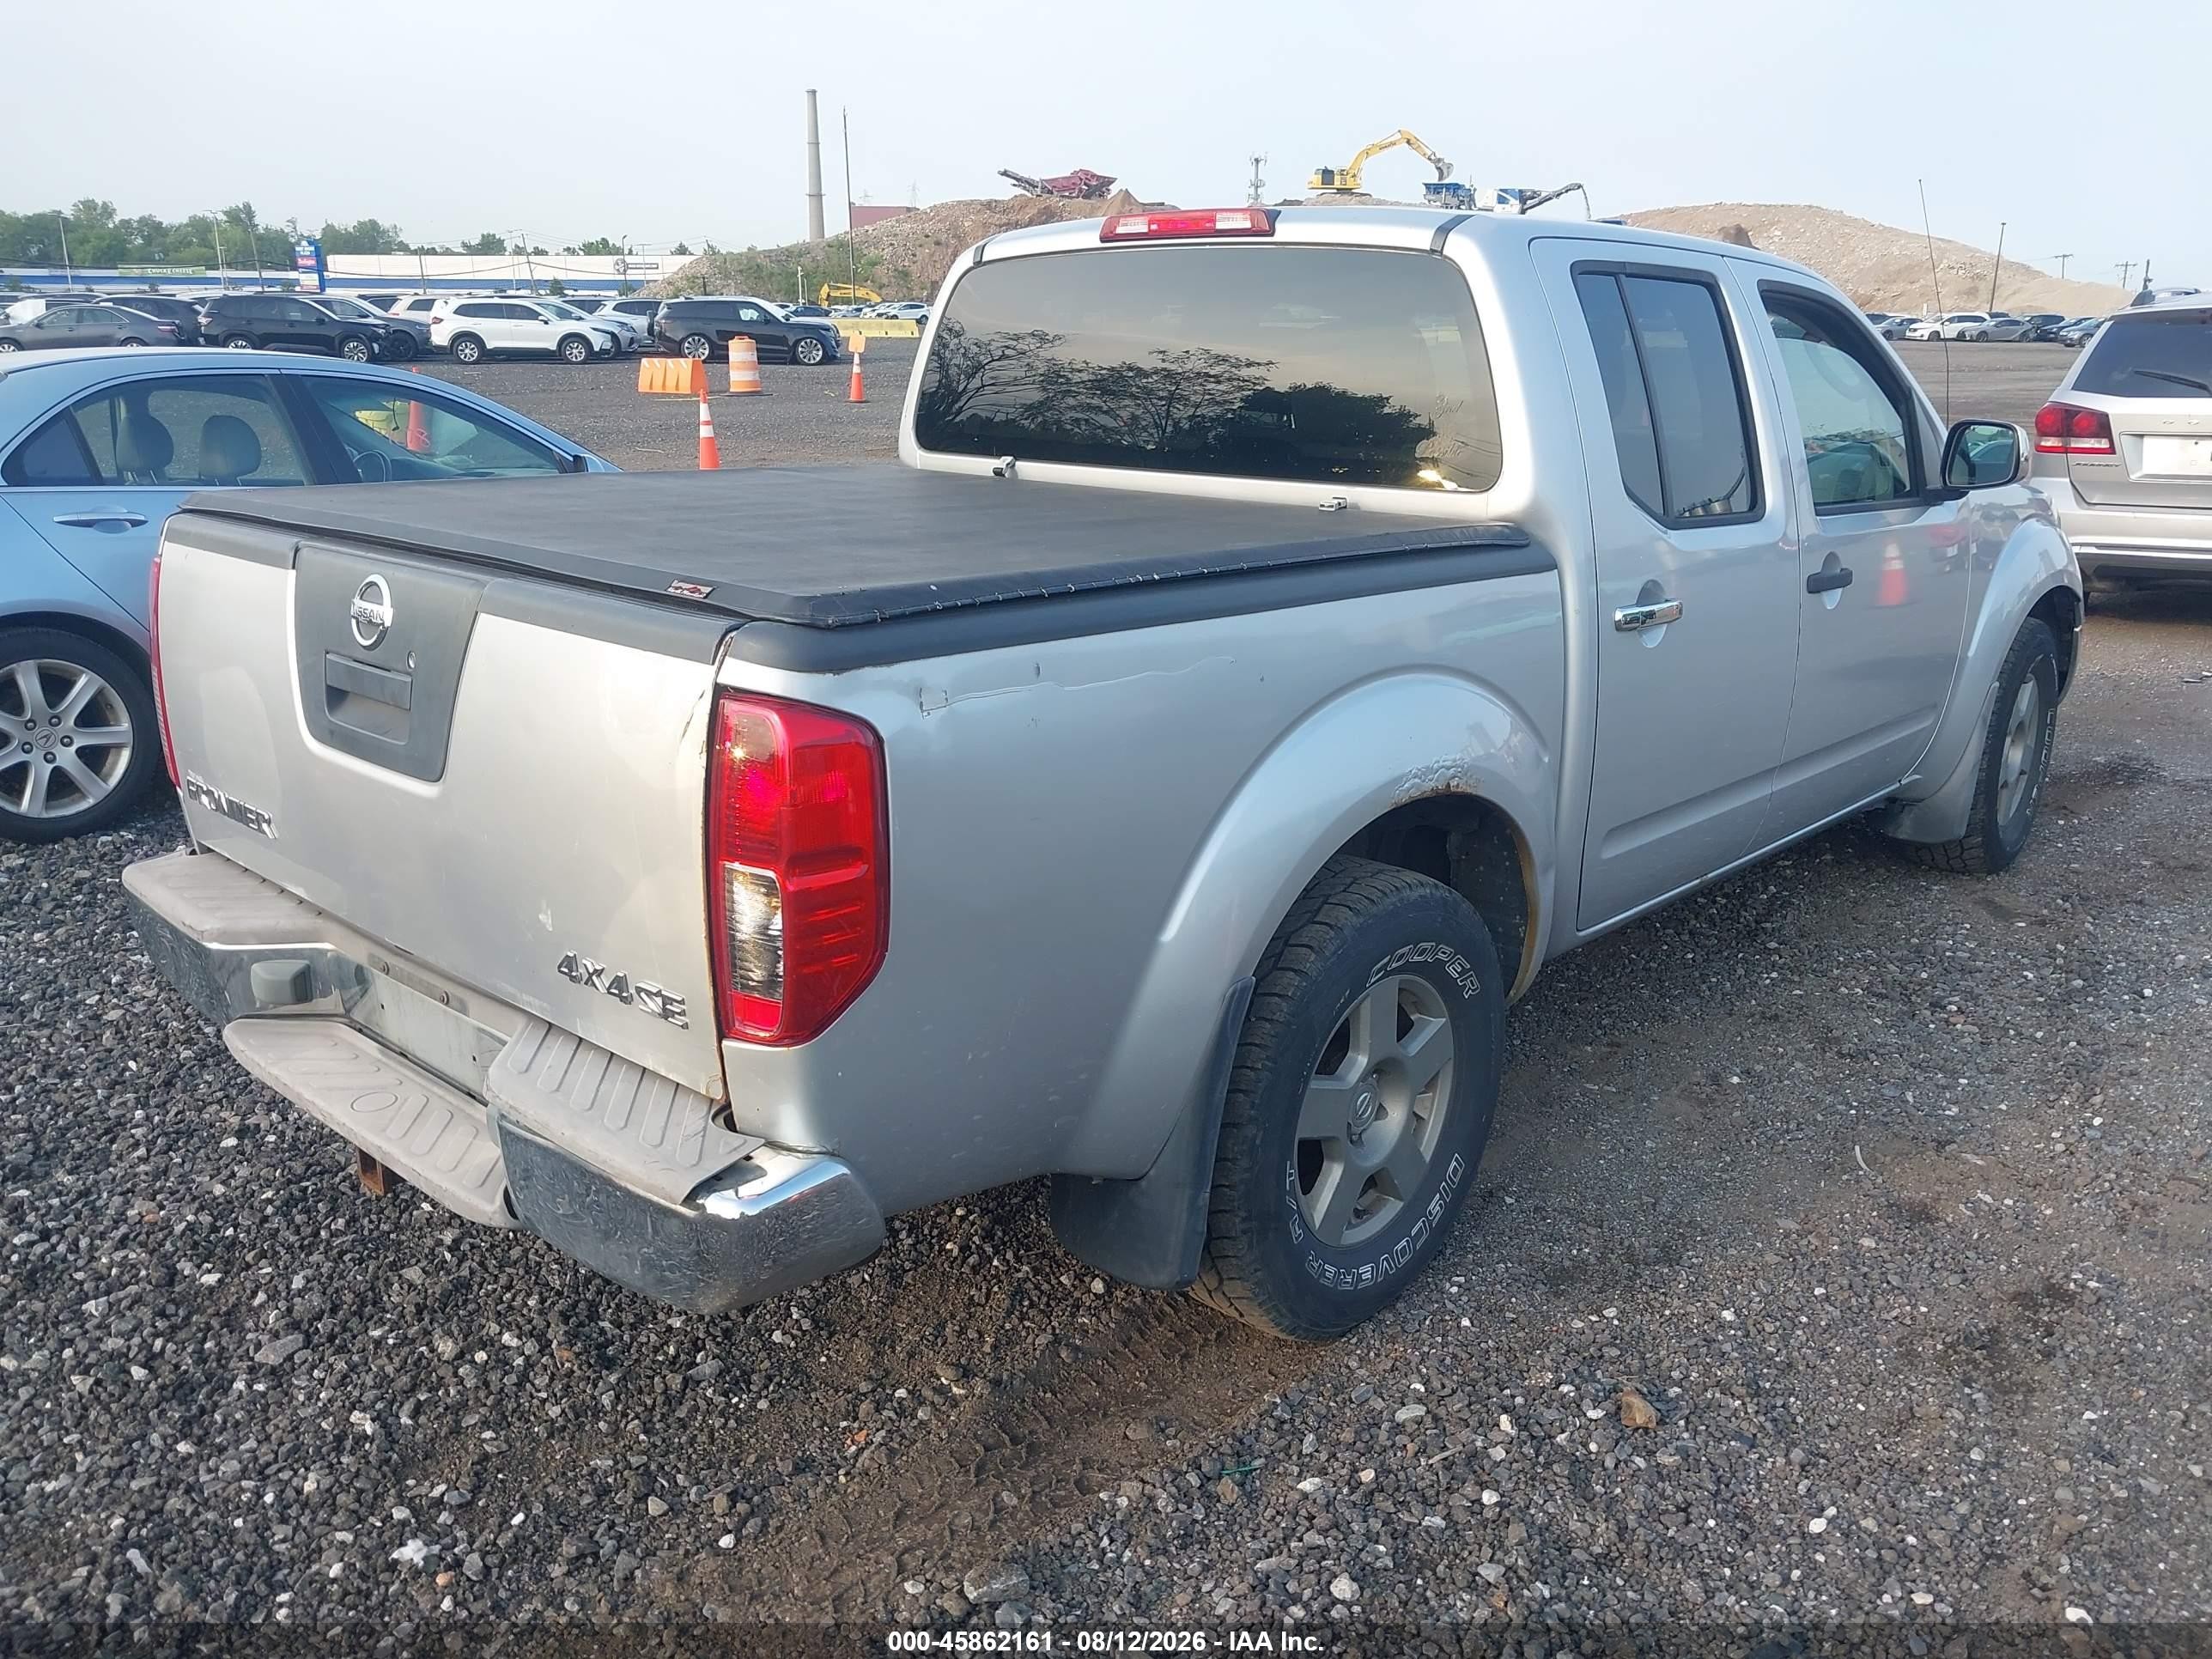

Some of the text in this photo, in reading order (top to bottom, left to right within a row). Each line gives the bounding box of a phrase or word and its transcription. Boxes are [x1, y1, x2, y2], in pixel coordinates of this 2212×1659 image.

[557, 951, 690, 1030] 4X4 SE
[1365, 941, 1481, 1000] COOPER
[1304, 1152, 1466, 1291] DISCOVERER
